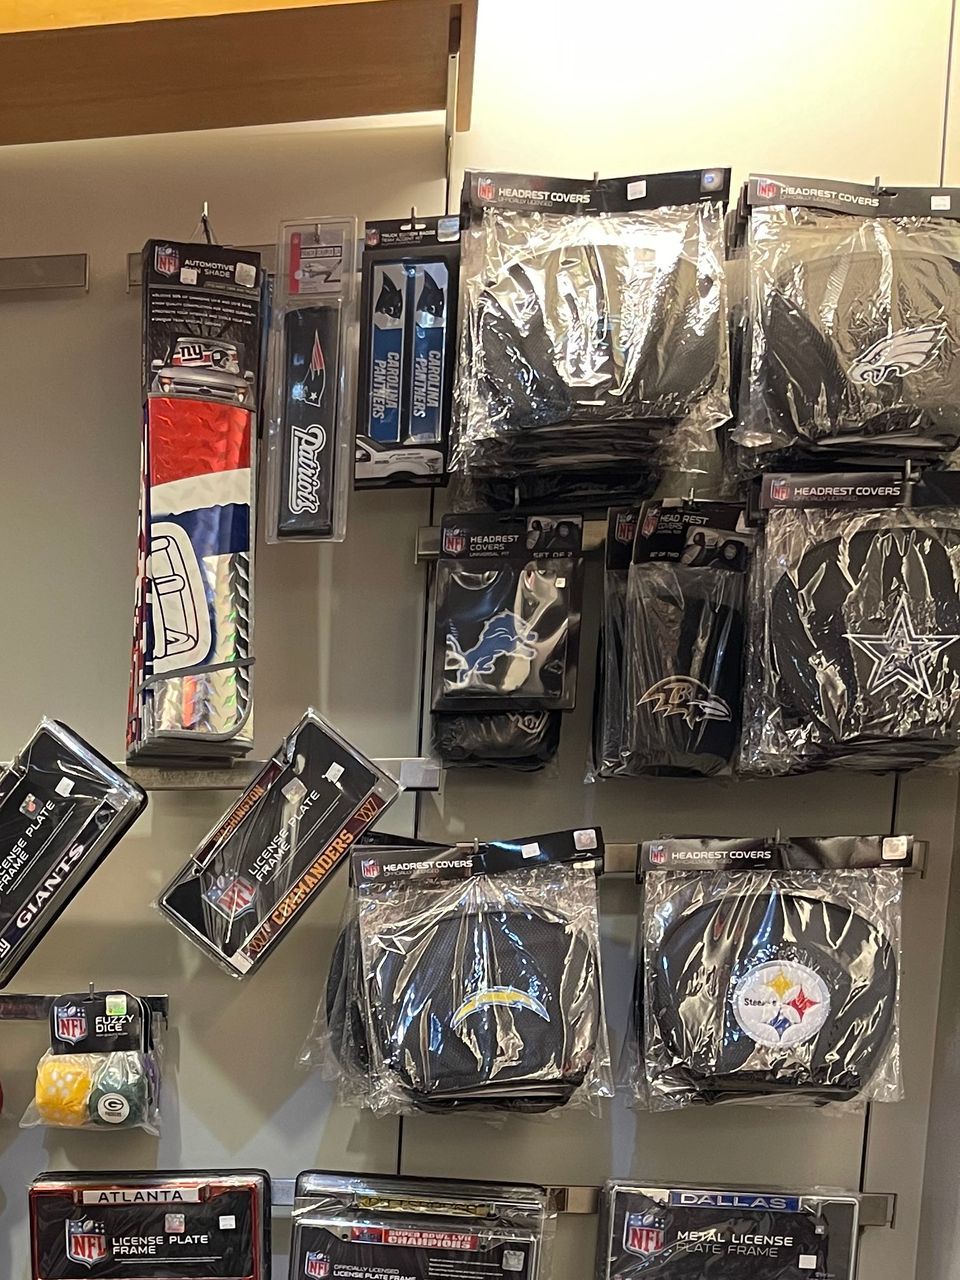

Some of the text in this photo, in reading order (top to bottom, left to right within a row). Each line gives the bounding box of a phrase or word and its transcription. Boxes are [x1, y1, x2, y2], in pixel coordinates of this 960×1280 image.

[498, 188, 591, 204] HEADREST COVERS
[780, 187, 837, 199] HEADREST
[838, 194, 880, 207] COVERS
[184, 259, 235, 271] AUTOMOTIVE
[204, 268, 231, 278] SHADE
[386, 351, 400, 409] CAROLINA
[426, 350, 441, 408] CAROLINA
[373, 359, 387, 420] PANTHERS
[413, 357, 427, 419] PANTHERS
[290, 424, 326, 514] Patriots
[794, 487, 901, 496] HEADREST COVERS
[660, 513, 709, 526] HEAD REST
[446, 536, 465, 550] NFL
[470, 535, 519, 544] HEADREST
[470, 543, 505, 551] COVERS
[26, 799, 56, 838] PLATE
[213, 785, 266, 843] WASHINGTON
[248, 789, 320, 876] LICENSE PLATE
[256, 842, 291, 882] FRAME
[671, 851, 772, 859] HEADREST COVERS
[383, 859, 473, 872] HEADREST COVERS
[272, 829, 354, 926] COMMANDERS
[16, 843, 85, 929] GIANTS
[218, 879, 255, 914] NFL
[58, 1017, 86, 1037] NFL
[95, 1014, 134, 1025] FUZZY
[95, 1023, 123, 1033] DICE
[104, 1098, 124, 1111] G
[98, 1190, 184, 1203] ATLANTA
[680, 1193, 787, 1209] DALLAS
[72, 1234, 106, 1255] NFL
[112, 1234, 209, 1245] LICENSE PLATE
[387, 1236, 471, 1249] CHAMPIONS
[628, 1227, 664, 1252] NFL
[677, 1231, 793, 1247] METAL LICENSE
[112, 1245, 156, 1255] FRAME
[676, 1243, 778, 1258] PLATE FRAME
[308, 1262, 329, 1276] NFL
[333, 1264, 400, 1275] OFFICIALLY LICENSED
[333, 1270, 364, 1279] LICENSE
[365, 1273, 388, 1280] PLATE
